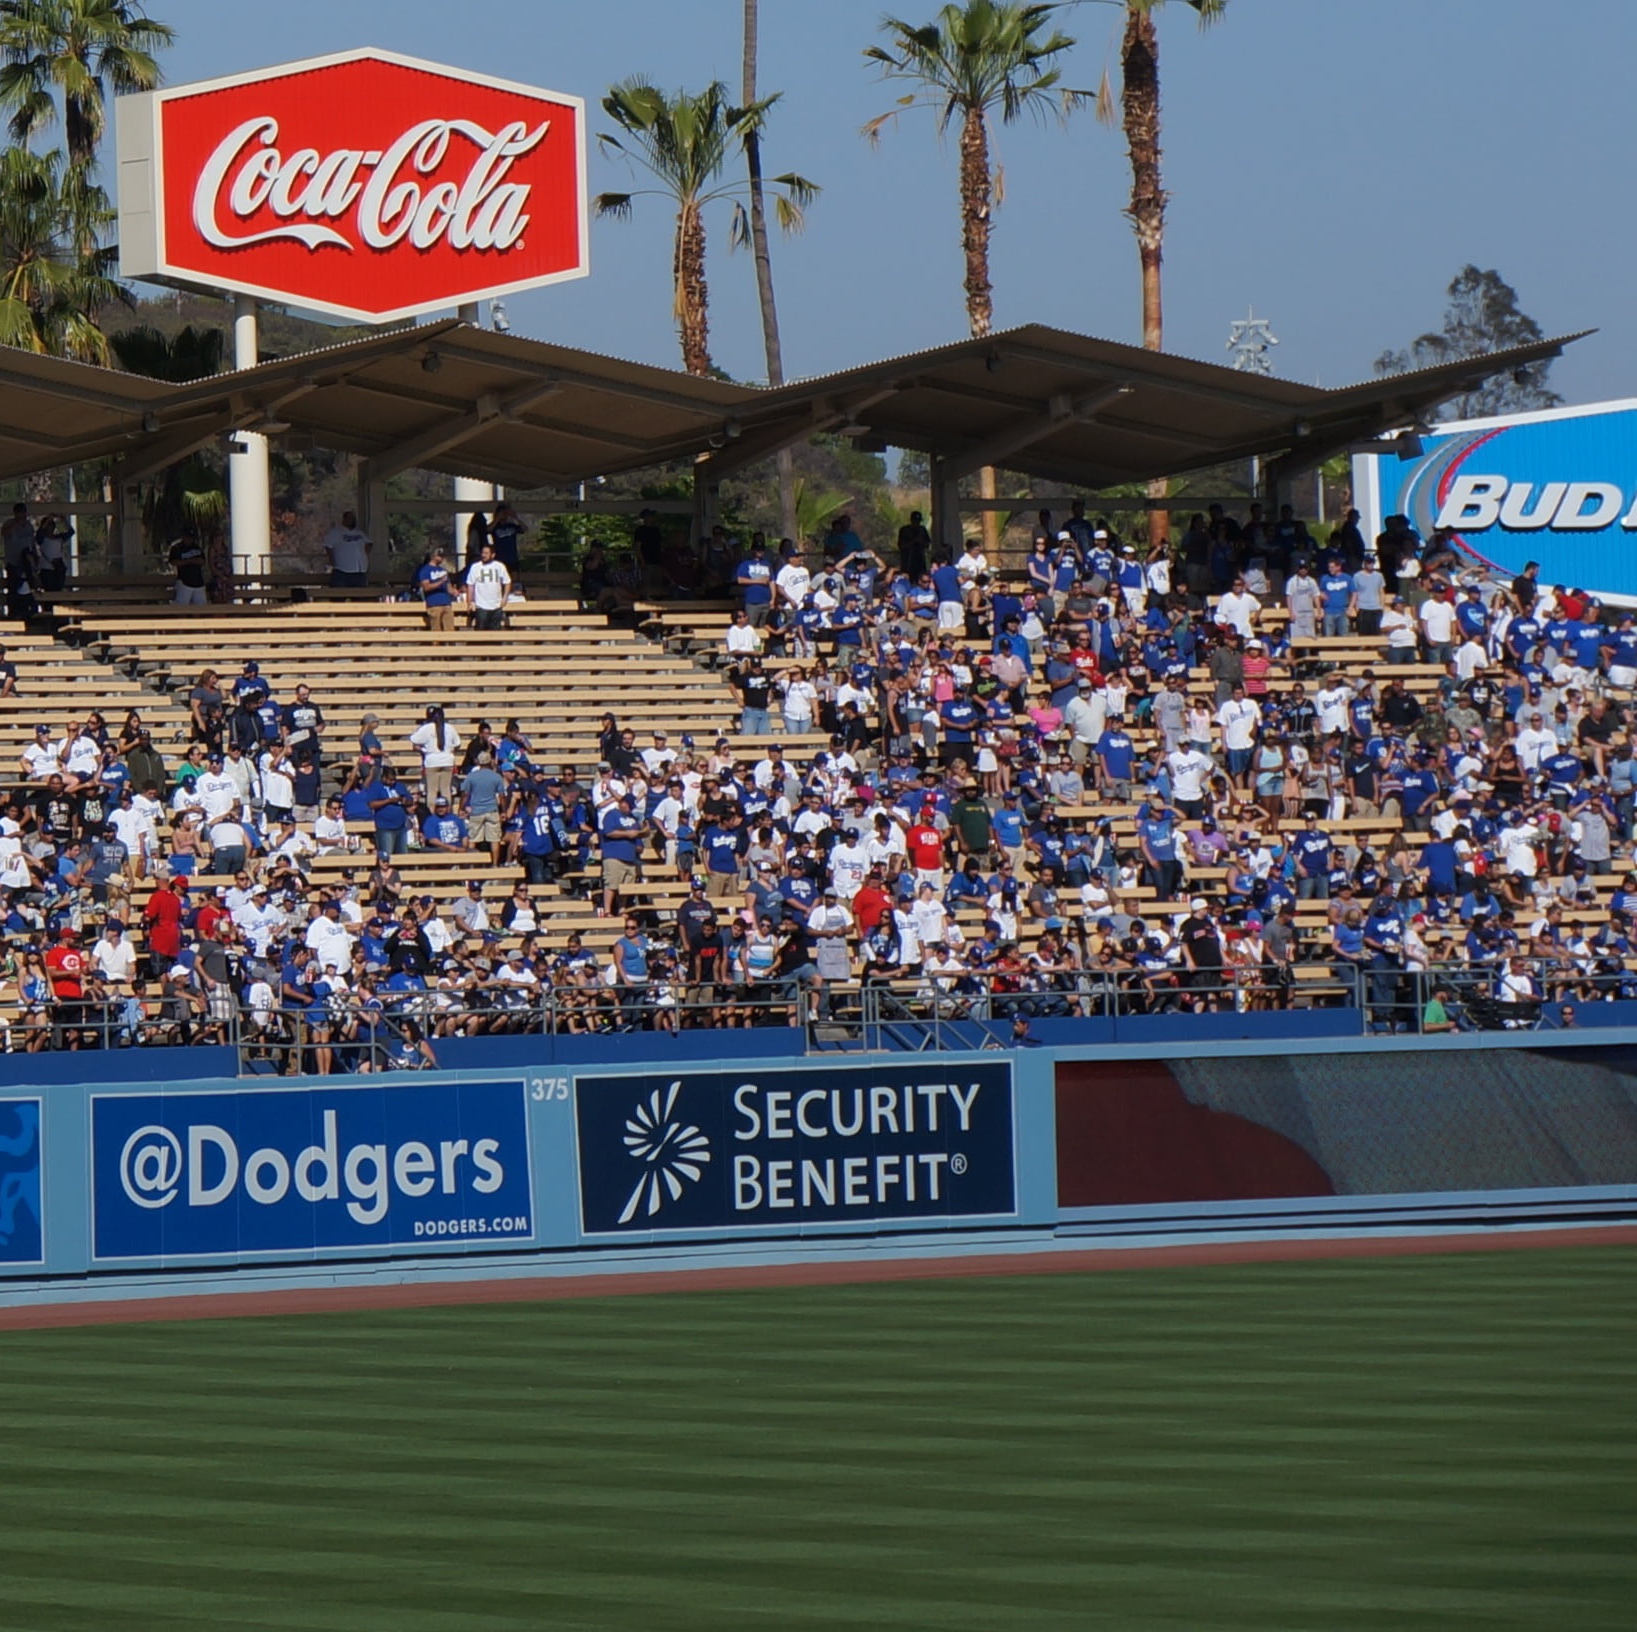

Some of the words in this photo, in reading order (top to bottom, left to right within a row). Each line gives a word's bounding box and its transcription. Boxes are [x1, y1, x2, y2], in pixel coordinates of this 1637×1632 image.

[192, 116, 551, 251] Coca-Cola
[1432, 474, 1624, 531] BUD
[531, 1077, 569, 1102] 375
[733, 1083, 981, 1141] SECURITY
[119, 1108, 504, 1226] @Dodgers
[413, 1215, 528, 1236] DODGERS.COM
